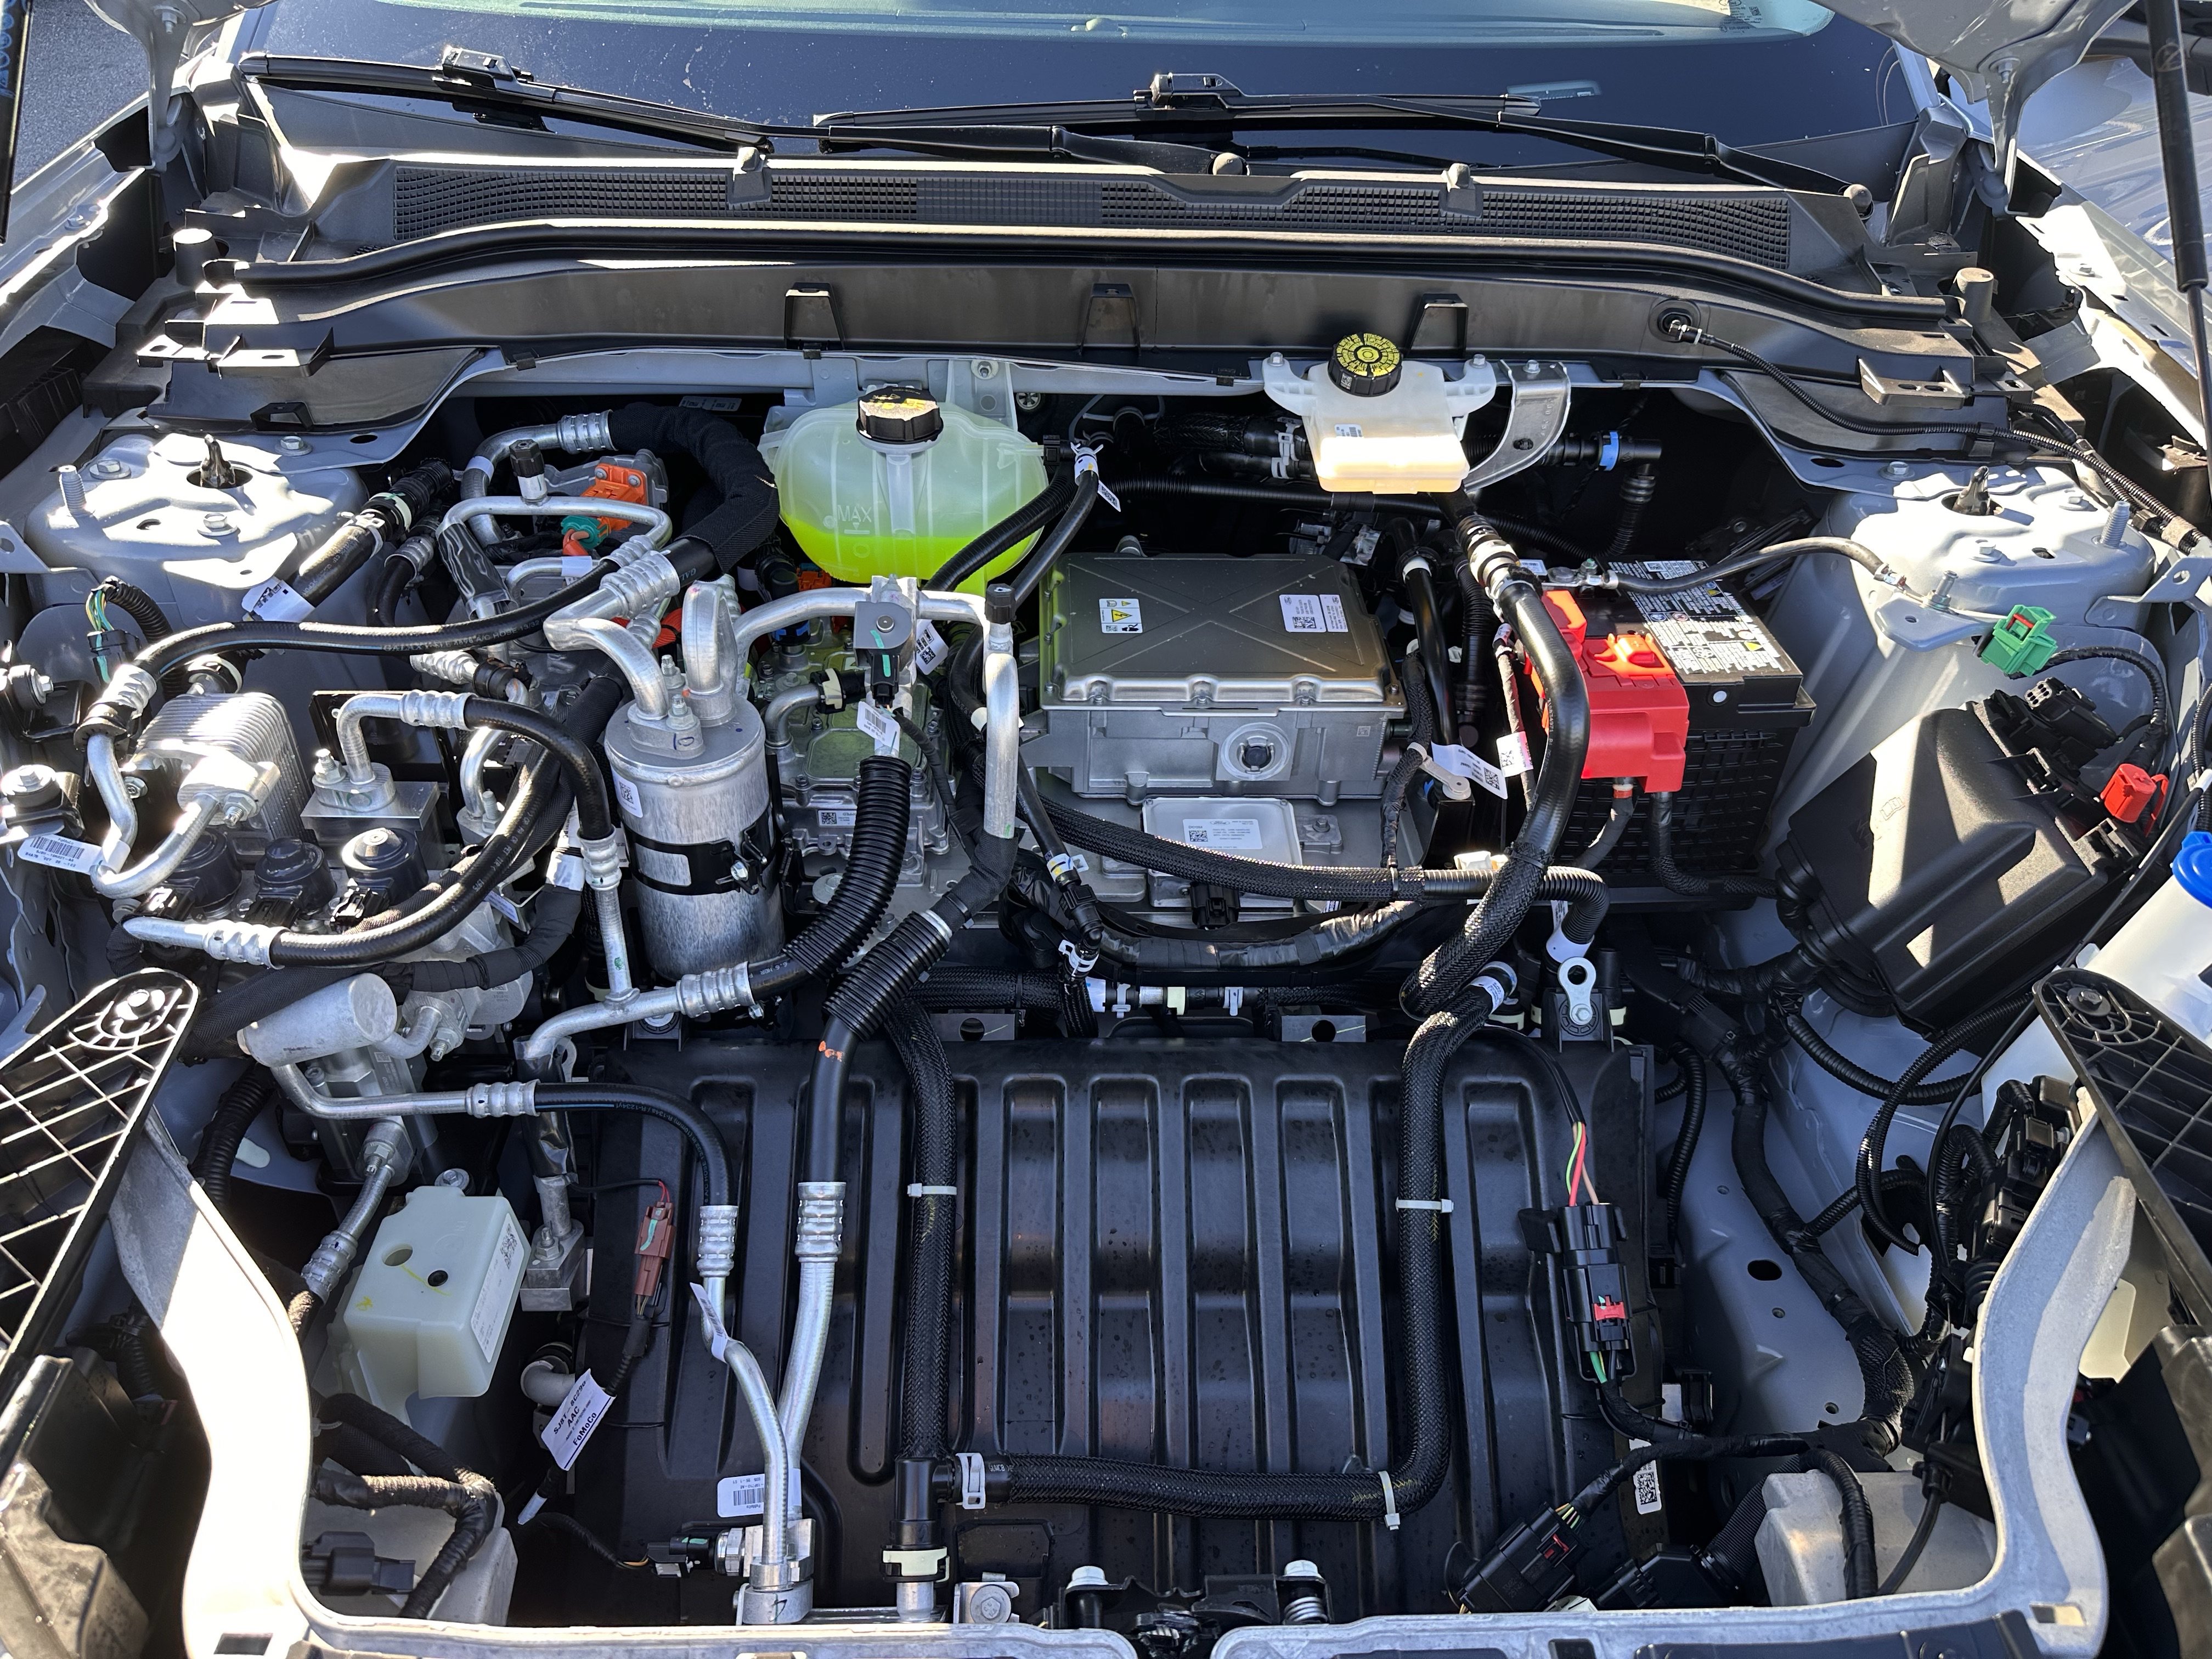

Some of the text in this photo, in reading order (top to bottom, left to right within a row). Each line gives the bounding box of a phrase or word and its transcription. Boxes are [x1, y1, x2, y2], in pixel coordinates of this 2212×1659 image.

[837, 505, 872, 523] MAX
[493, 627, 517, 639] HOSE
[567, 1406, 580, 1427] AAC
[573, 1412, 597, 1446] FoMoCo
